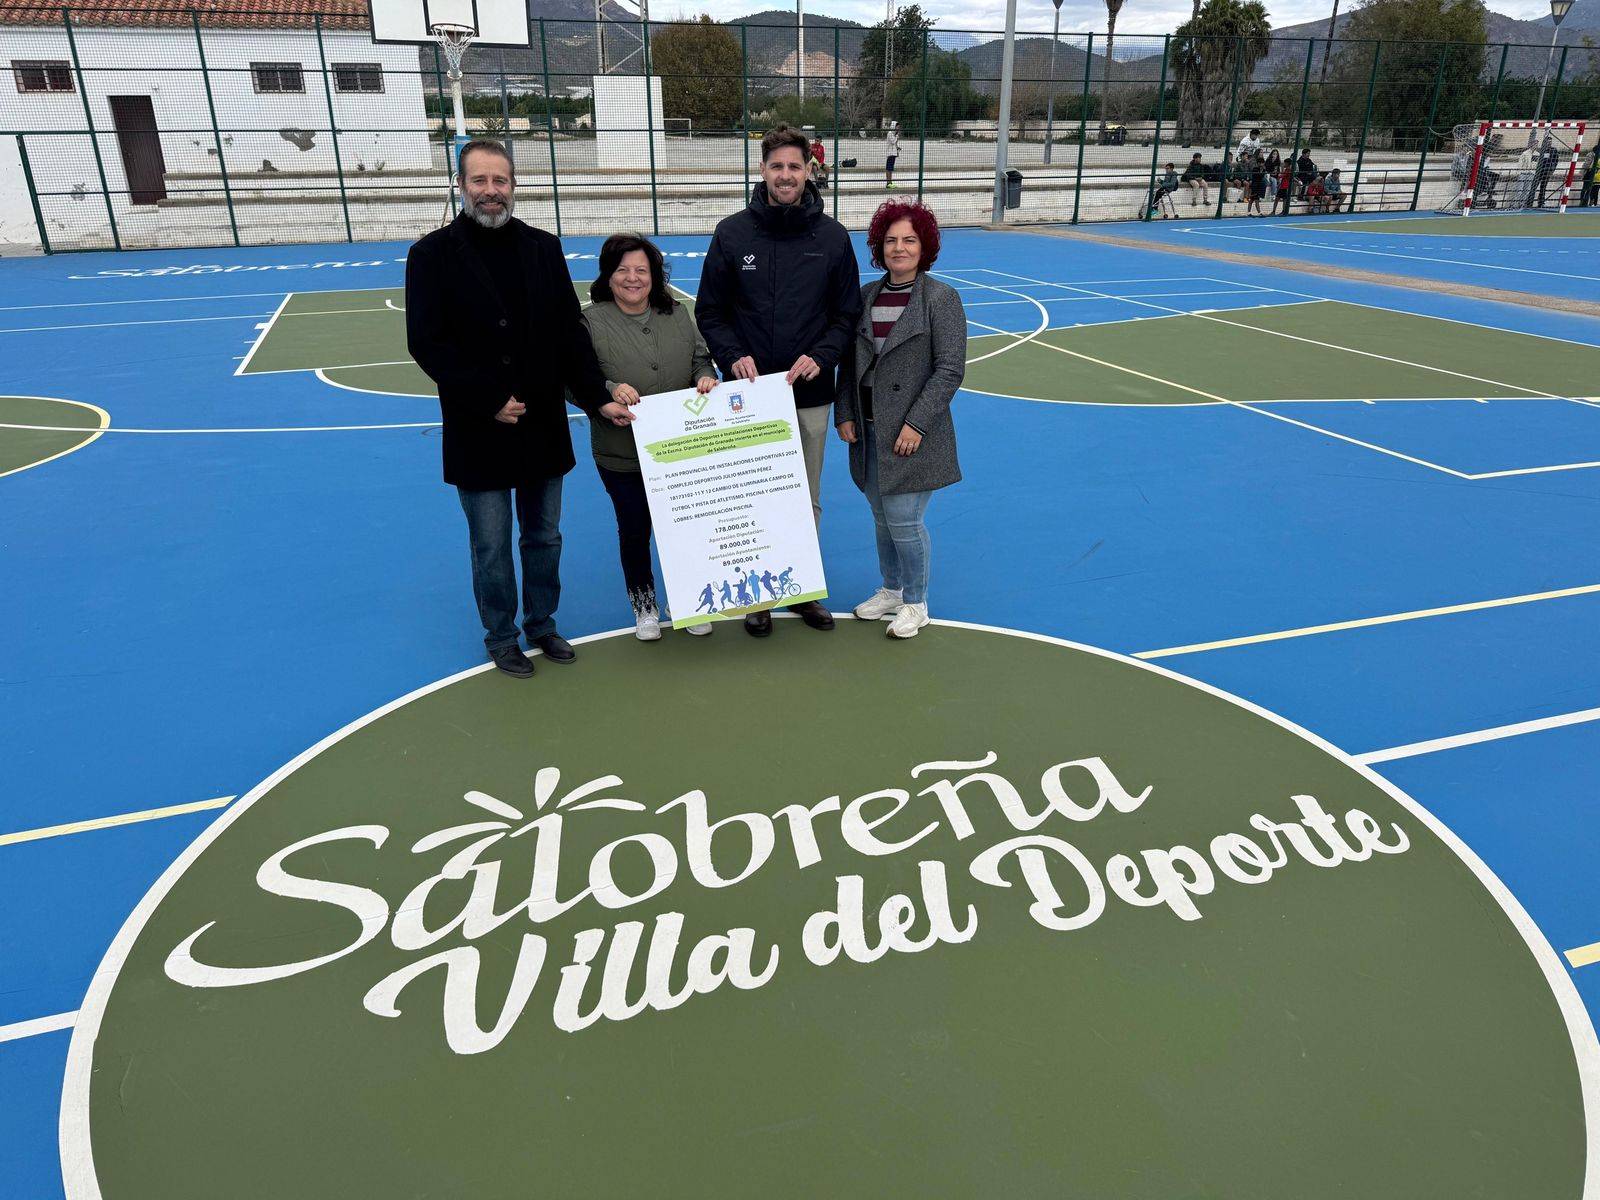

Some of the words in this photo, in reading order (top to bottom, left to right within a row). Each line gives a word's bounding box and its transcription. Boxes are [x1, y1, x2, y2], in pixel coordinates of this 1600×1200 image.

[684, 416, 715, 426] Diputación
[693, 422, 716, 430] Granada
[679, 467, 708, 476] PROVINCIAL
[717, 458, 754, 469] INSTALACIONES
[755, 452, 785, 462] DEPORTIVAS
[667, 482, 694, 490] COMPLEJO
[694, 476, 722, 485] DEPORTIVO
[737, 469, 756, 477] MARTÍN
[712, 485, 732, 493] CAMBIO
[769, 485, 794, 493] GIMNASIO
[694, 507, 733, 519] REMODELACIÓN
[715, 522, 749, 534] 178.000,00
[720, 539, 751, 550] 89.000,00
[722, 556, 754, 567] 89.000,00
[164, 751, 1152, 988] Salobreña
[363, 911, 779, 1055] Villa
[802, 860, 978, 966] del
[969, 794, 1411, 931] Deporte
